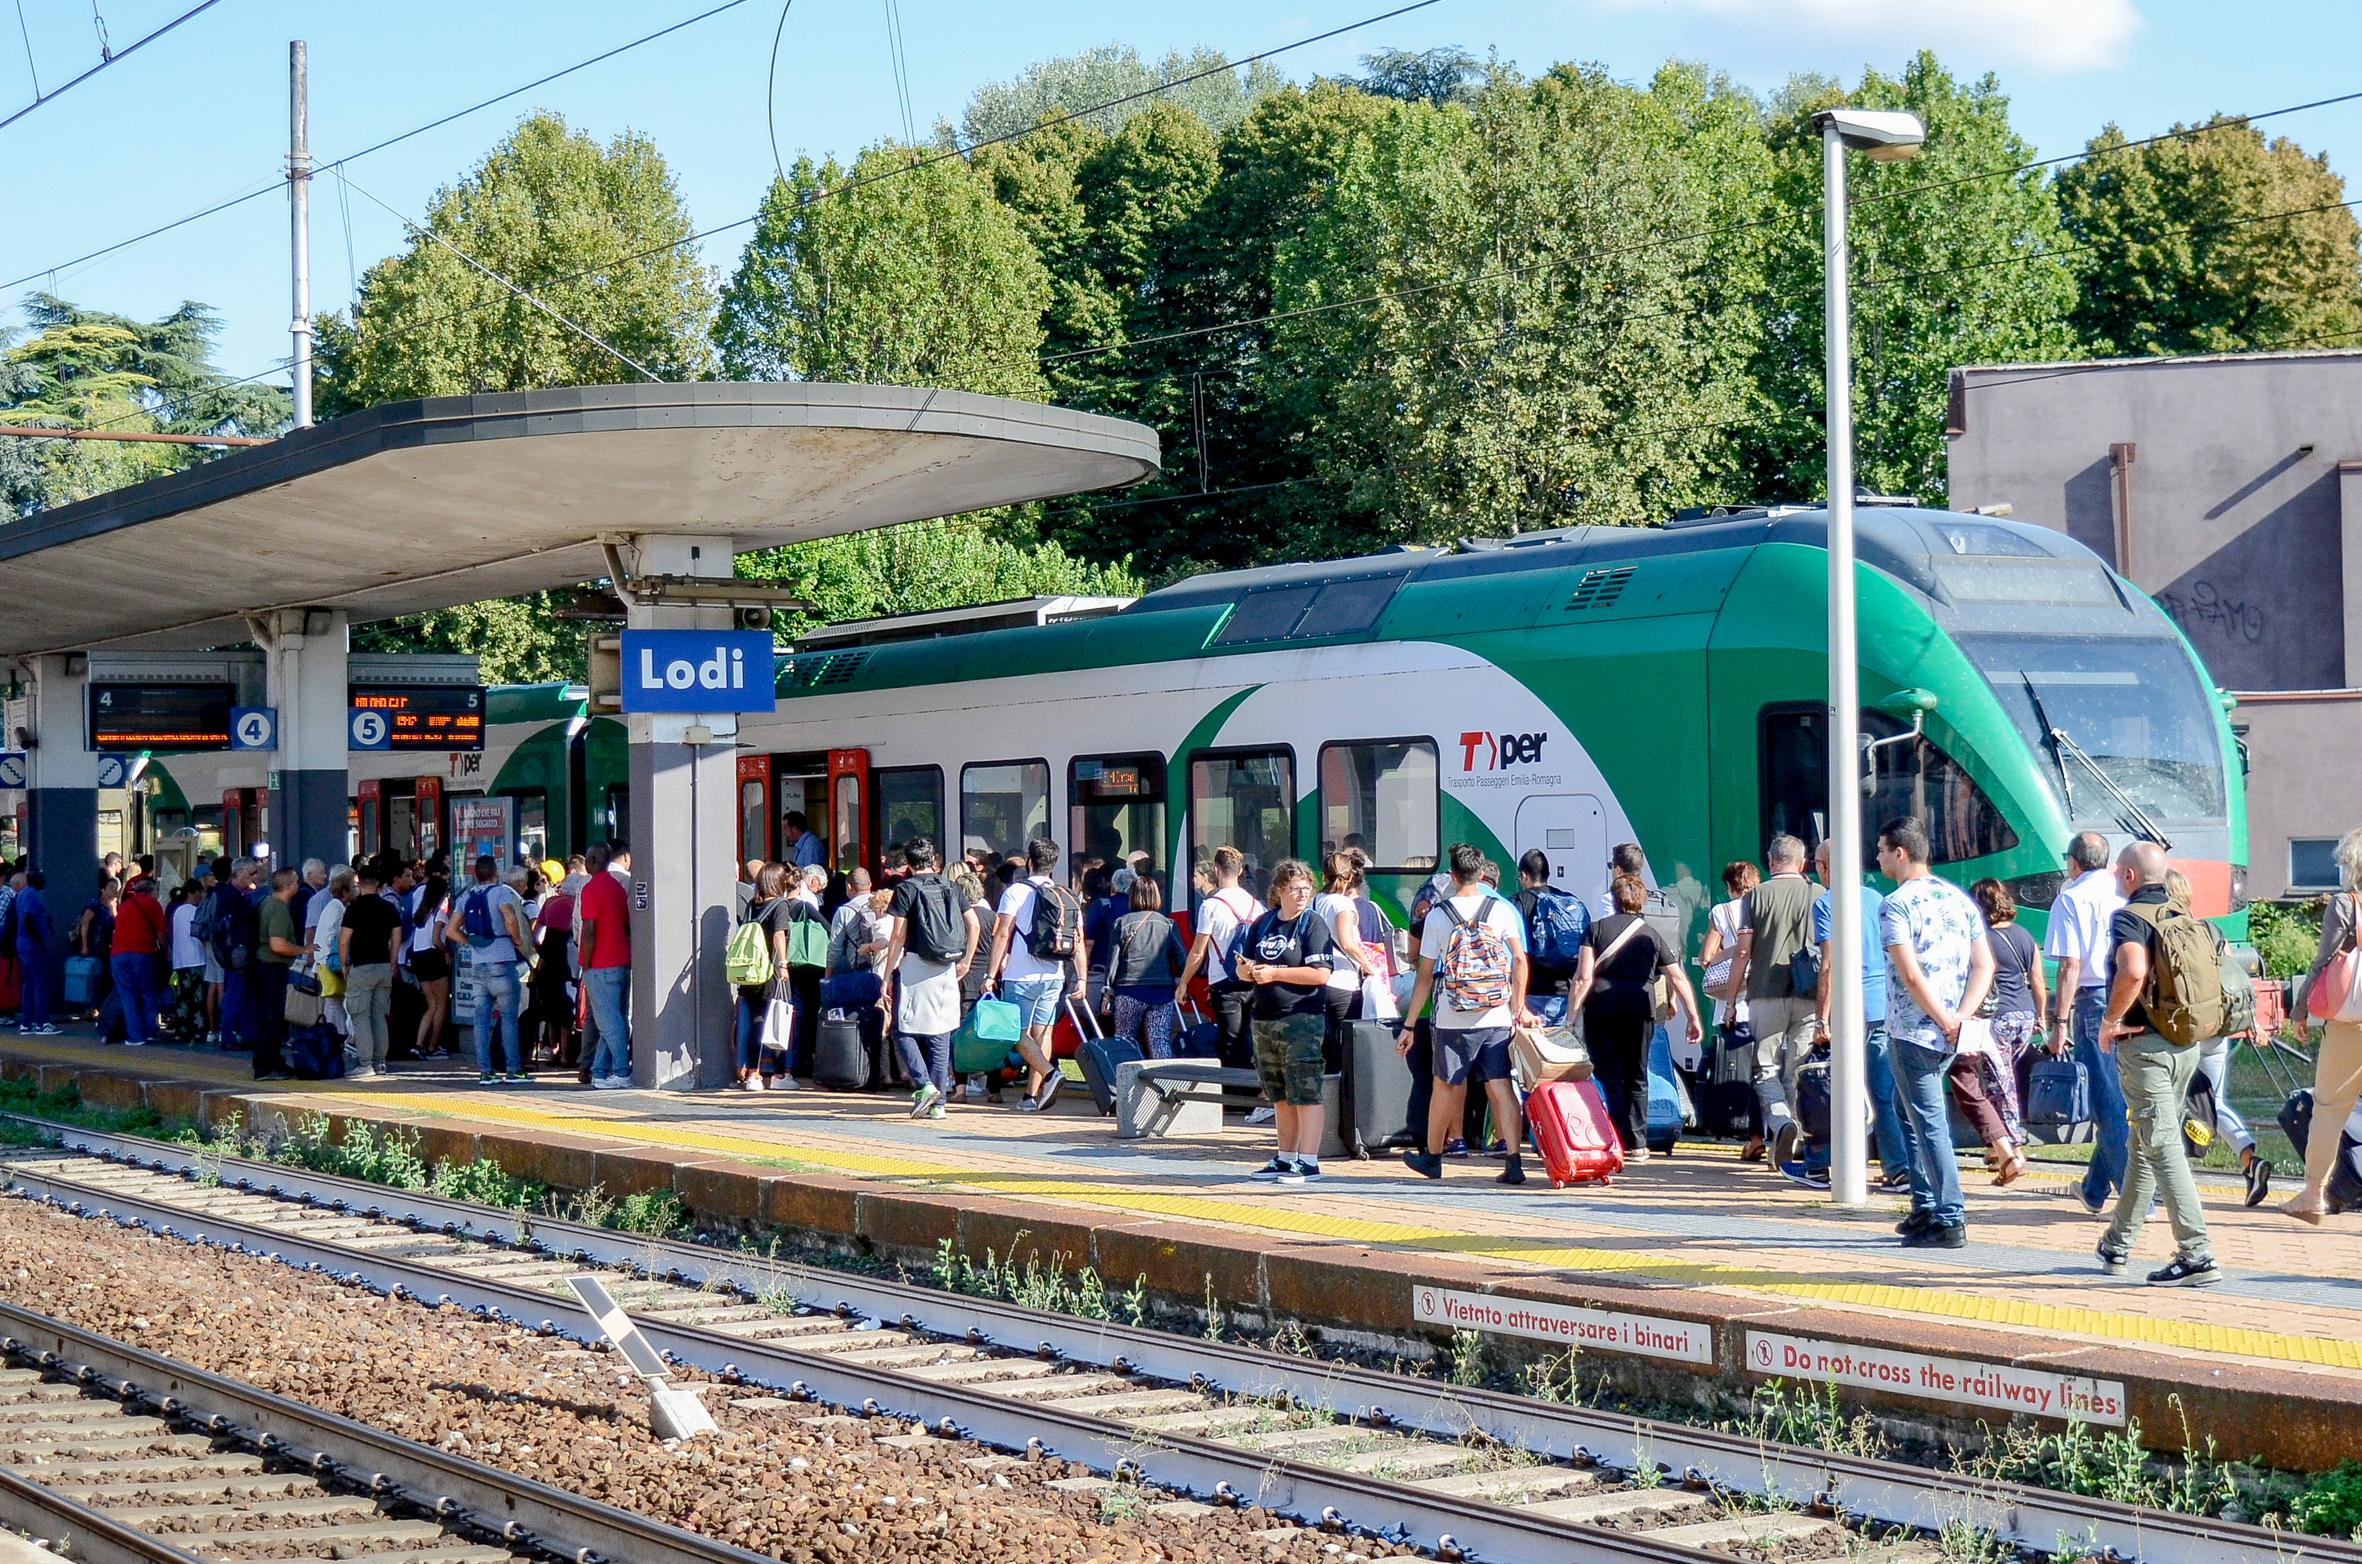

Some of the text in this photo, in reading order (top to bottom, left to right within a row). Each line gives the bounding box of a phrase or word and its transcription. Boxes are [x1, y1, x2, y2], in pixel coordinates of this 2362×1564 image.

[641, 647, 744, 690] Lodi
[100, 691, 112, 706] 4
[467, 694, 478, 708] 5
[244, 719, 262, 740] 4
[362, 718, 378, 740] 5
[1448, 776, 1475, 788] Trasporto
[1476, 775, 1510, 789] Passeggeri
[1443, 1296, 1689, 1352] Vietato attraversare i binari
[1783, 1344, 2116, 1416] Do not cross the railway lines
